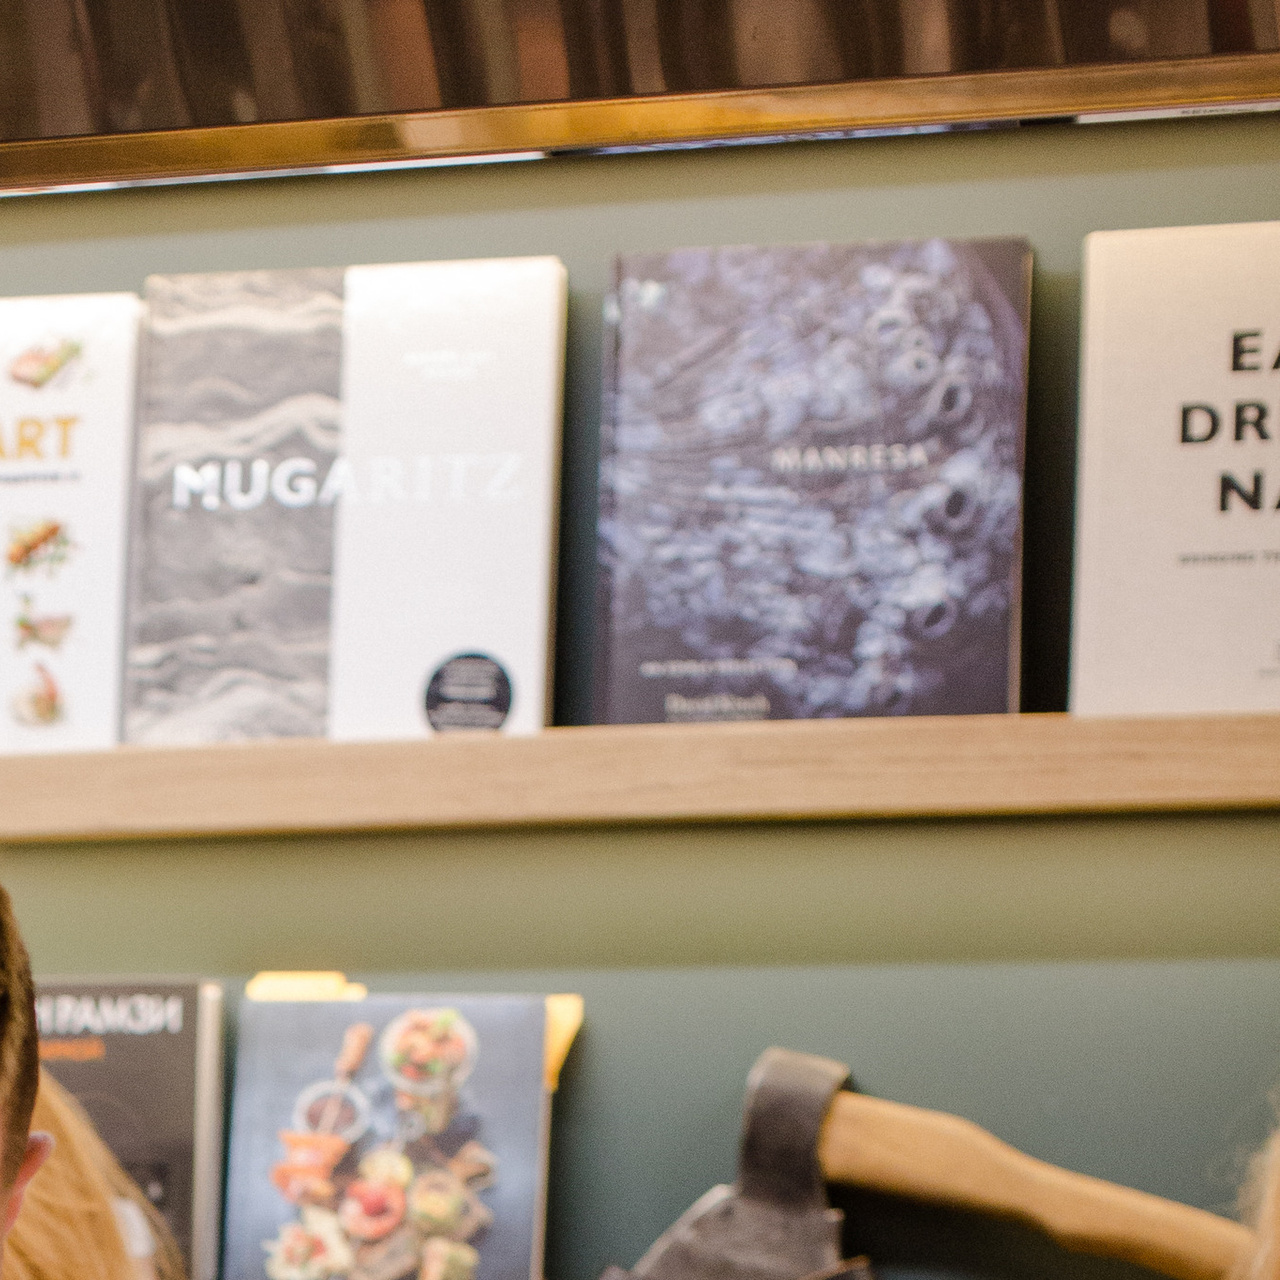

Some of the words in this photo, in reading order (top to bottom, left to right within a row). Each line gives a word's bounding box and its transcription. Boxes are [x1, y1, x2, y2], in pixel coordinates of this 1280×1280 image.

[1230, 328, 1280, 372] E
[771, 443, 930, 473] MANRESA
[171, 451, 524, 511] MUGARITZ
[1218, 472, 1280, 513] N
